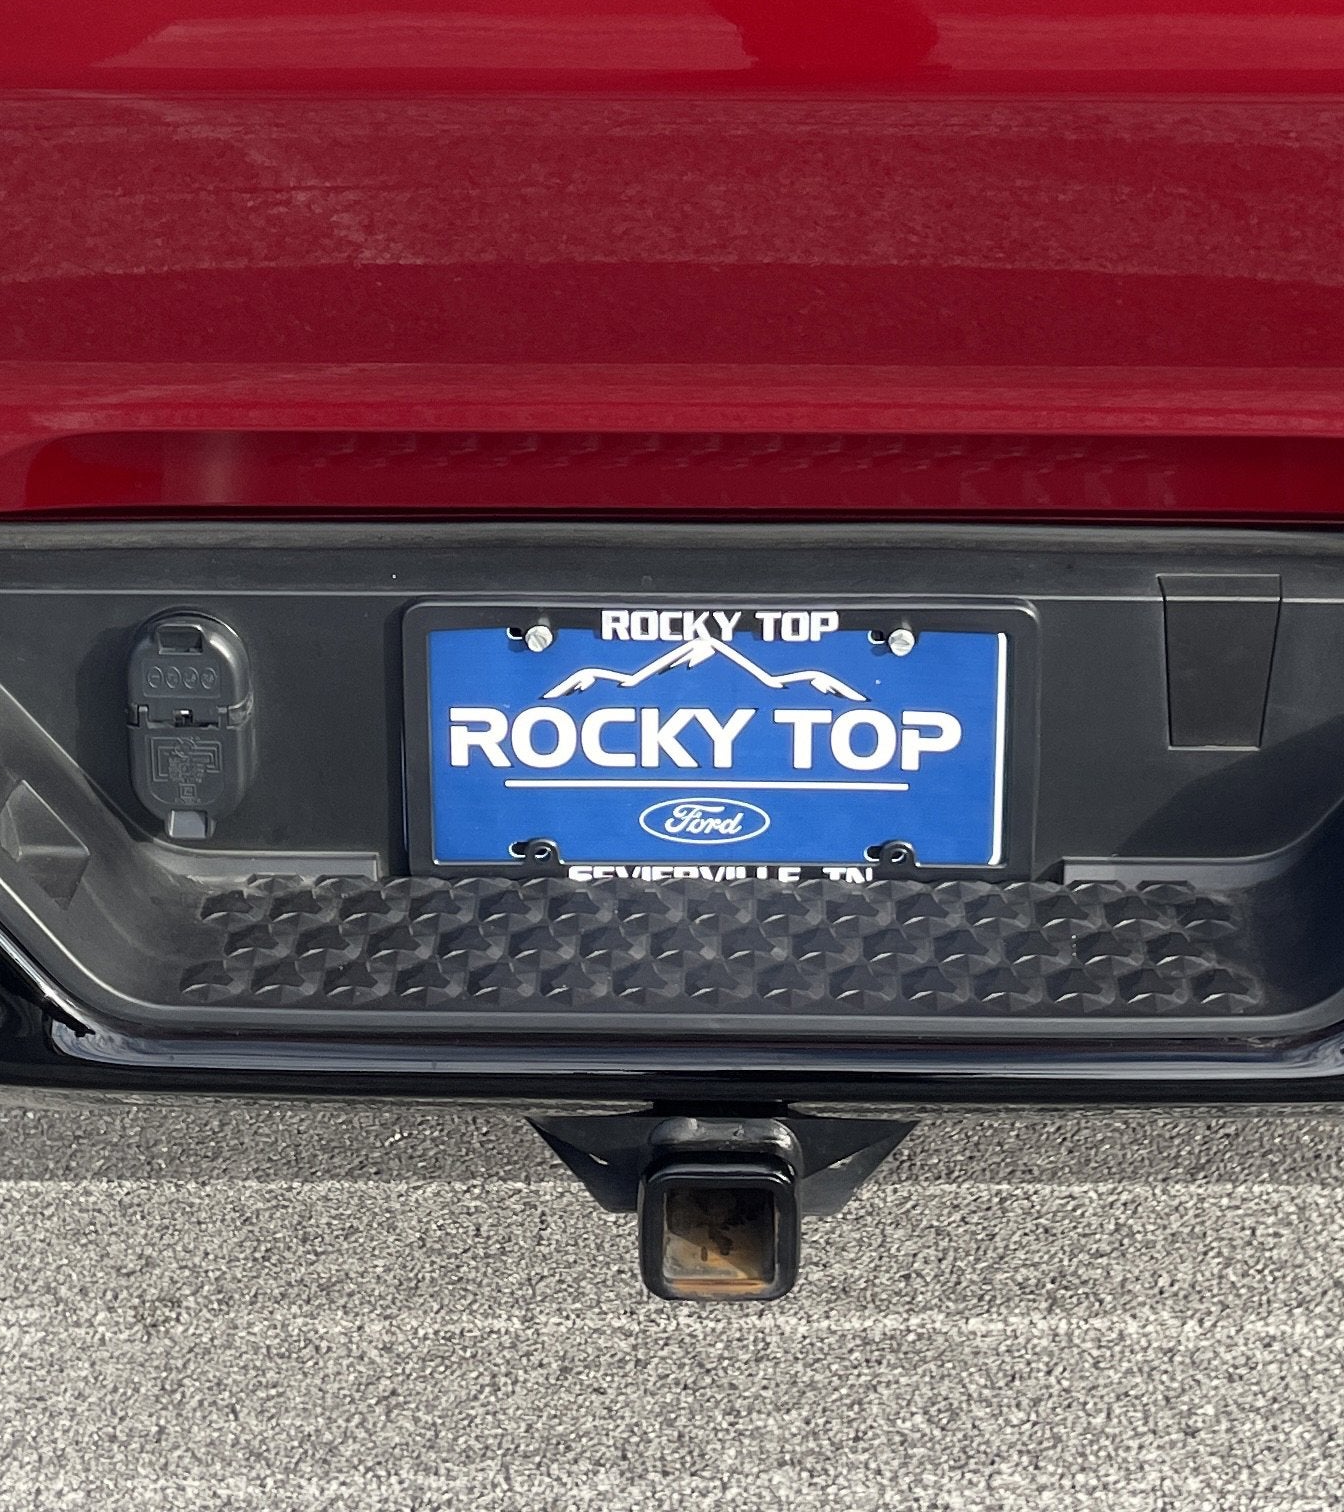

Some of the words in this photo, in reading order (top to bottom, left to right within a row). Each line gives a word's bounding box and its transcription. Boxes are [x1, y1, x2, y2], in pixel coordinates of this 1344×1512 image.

[599, 609, 741, 642] ROCKY
[756, 609, 839, 642] TOP
[448, 706, 757, 769] ROCKY
[773, 709, 962, 772] TOP
[664, 804, 744, 835] Ford
